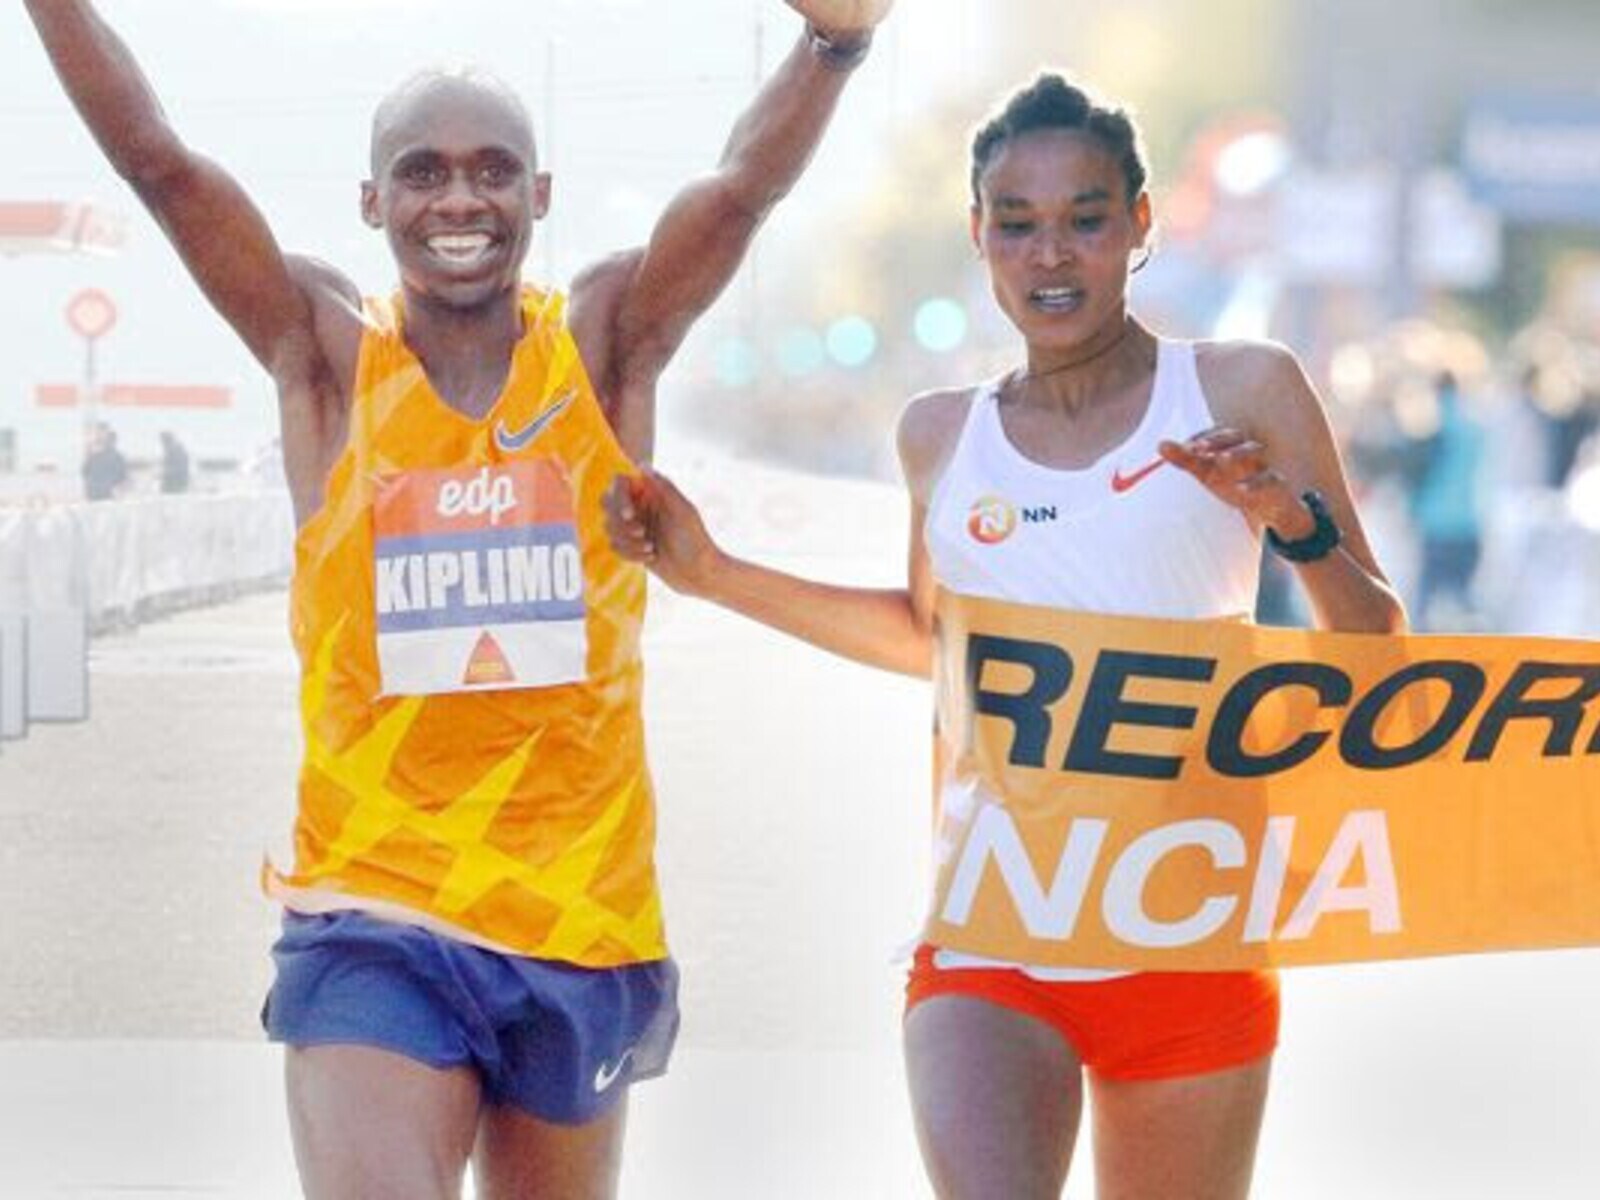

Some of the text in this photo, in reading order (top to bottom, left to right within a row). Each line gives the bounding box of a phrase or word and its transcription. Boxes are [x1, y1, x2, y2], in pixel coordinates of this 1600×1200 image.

[437, 467, 517, 525] edp
[1022, 505, 1057, 522] NN
[377, 543, 582, 613] KIPLIMO
[966, 632, 1600, 780] RECOR
